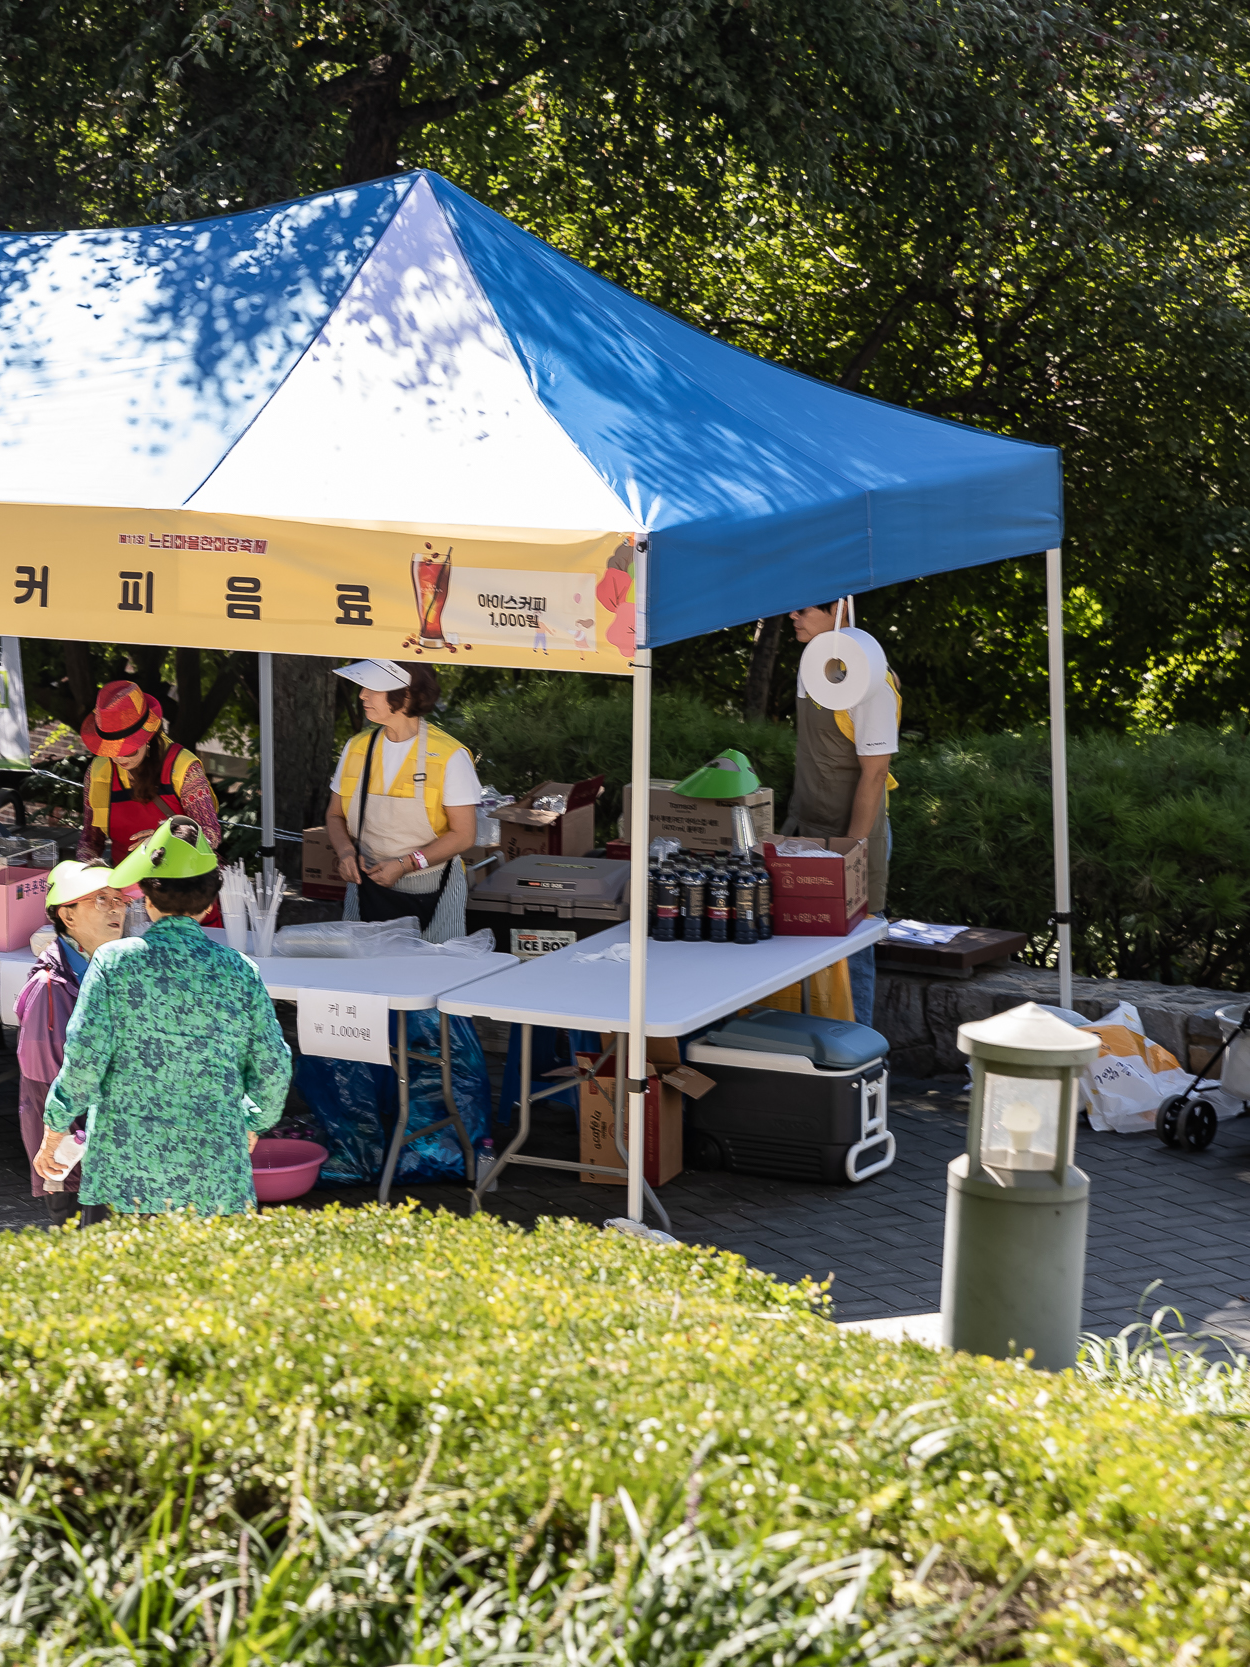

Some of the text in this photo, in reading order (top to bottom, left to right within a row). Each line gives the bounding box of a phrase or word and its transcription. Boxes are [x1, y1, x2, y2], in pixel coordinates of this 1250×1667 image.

[148, 533, 269, 555] 느티마을한마당축제
[478, 594, 546, 612] 아이스커피
[489, 612, 541, 628] 1,000원
[518, 940, 540, 951] ICE
